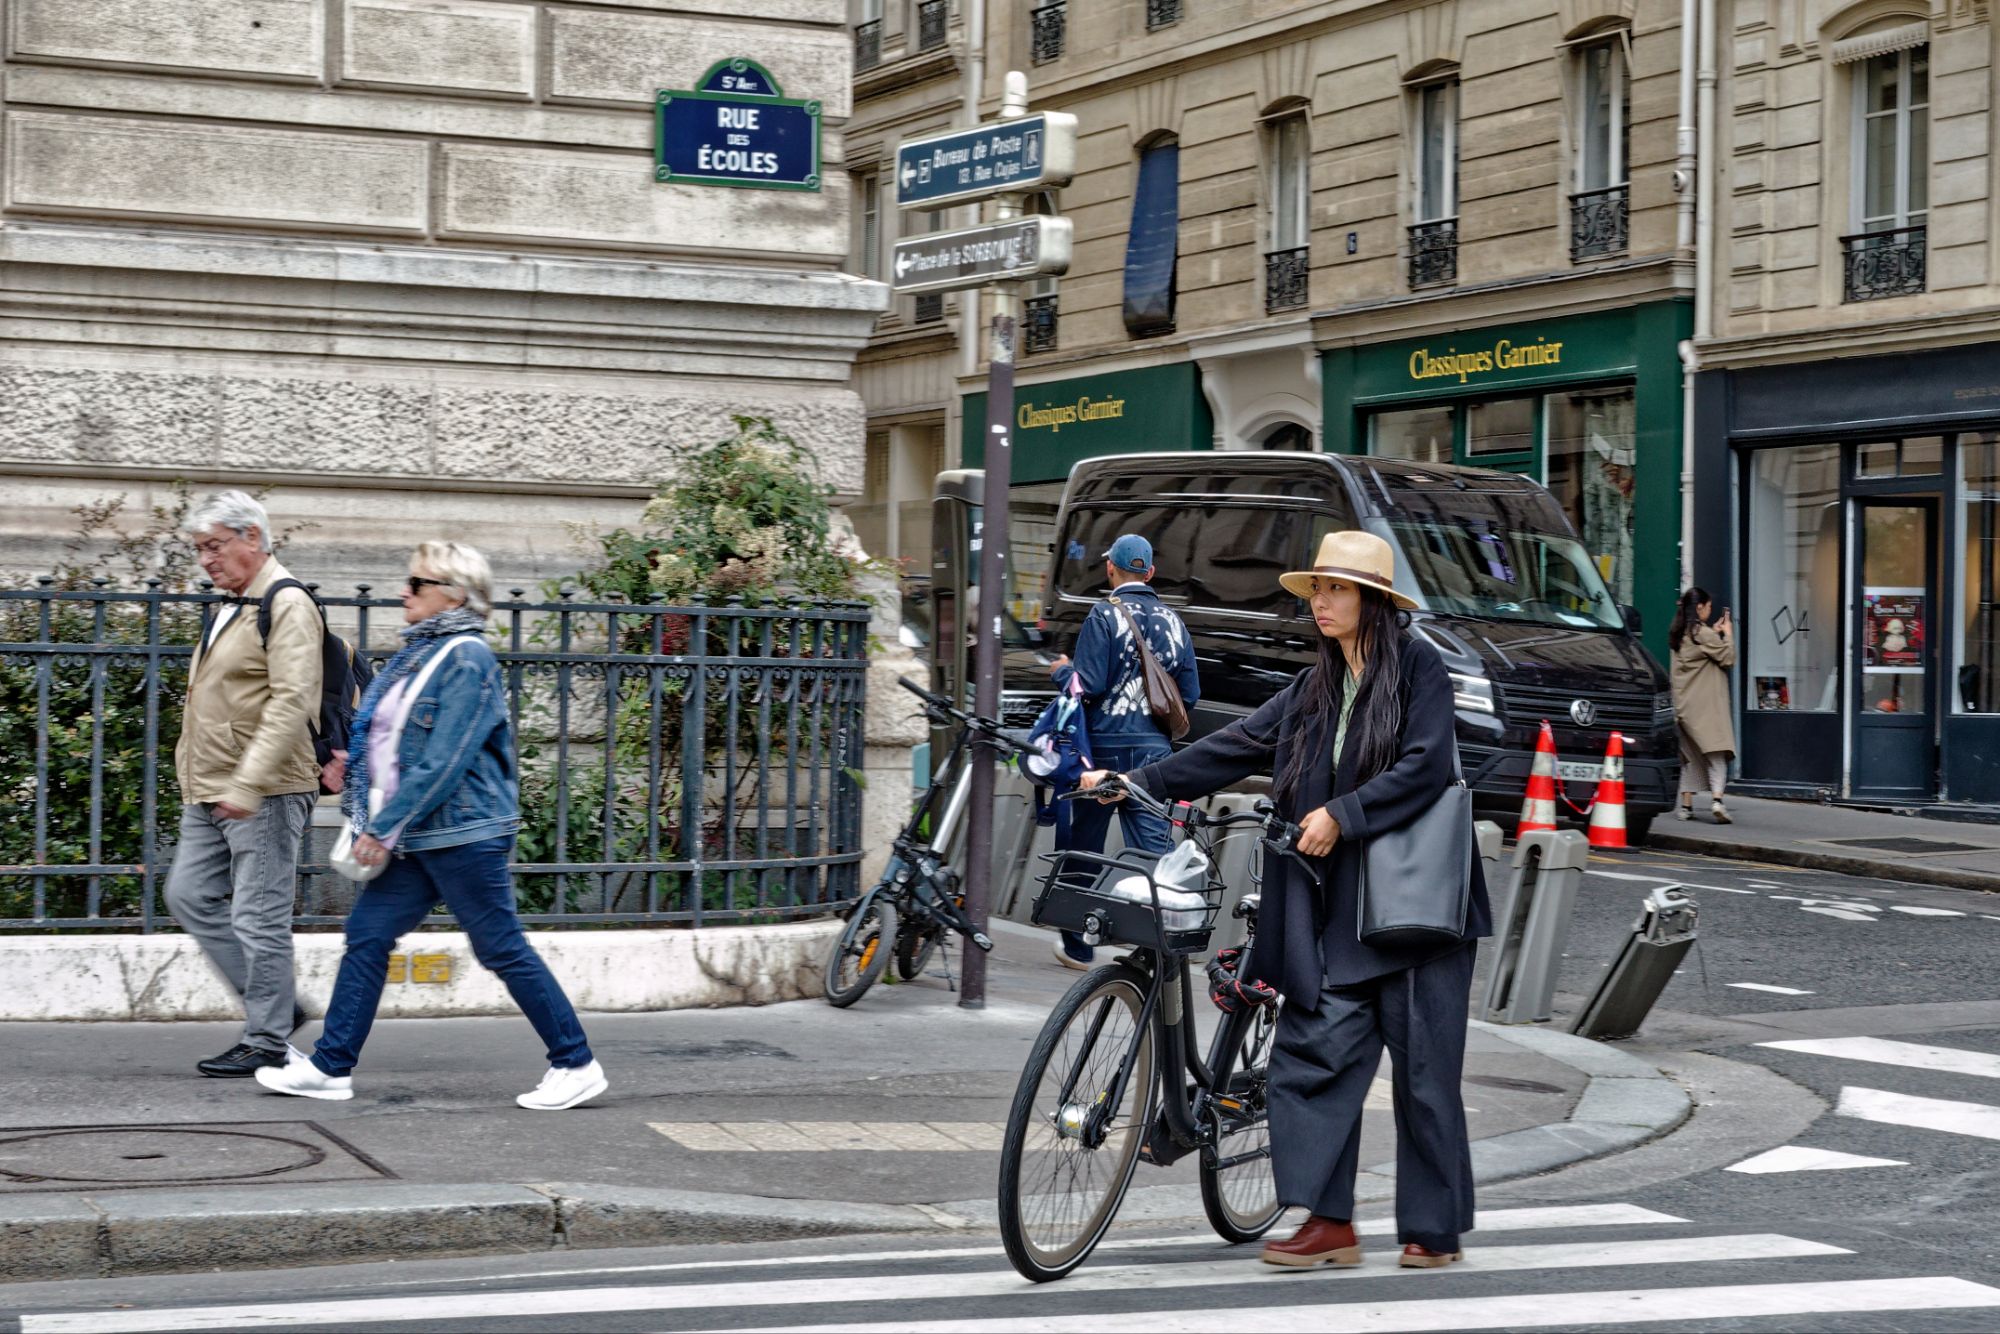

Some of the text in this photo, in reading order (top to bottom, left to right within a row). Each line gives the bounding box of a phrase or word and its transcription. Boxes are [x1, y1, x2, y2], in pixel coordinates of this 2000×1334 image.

[717, 107, 760, 130] RUE
[727, 133, 750, 146] DES
[932, 136, 1022, 169] Bureau de Poste
[697, 144, 779, 174] ÉCOLES
[973, 165, 992, 181] Rue
[993, 160, 1020, 180] Cujas
[909, 253, 937, 272] Place
[937, 248, 951, 268] de
[951, 247, 961, 266] la
[1409, 336, 1563, 383] Classiques Garnier
[1018, 394, 1125, 433] Classiques Garnier
